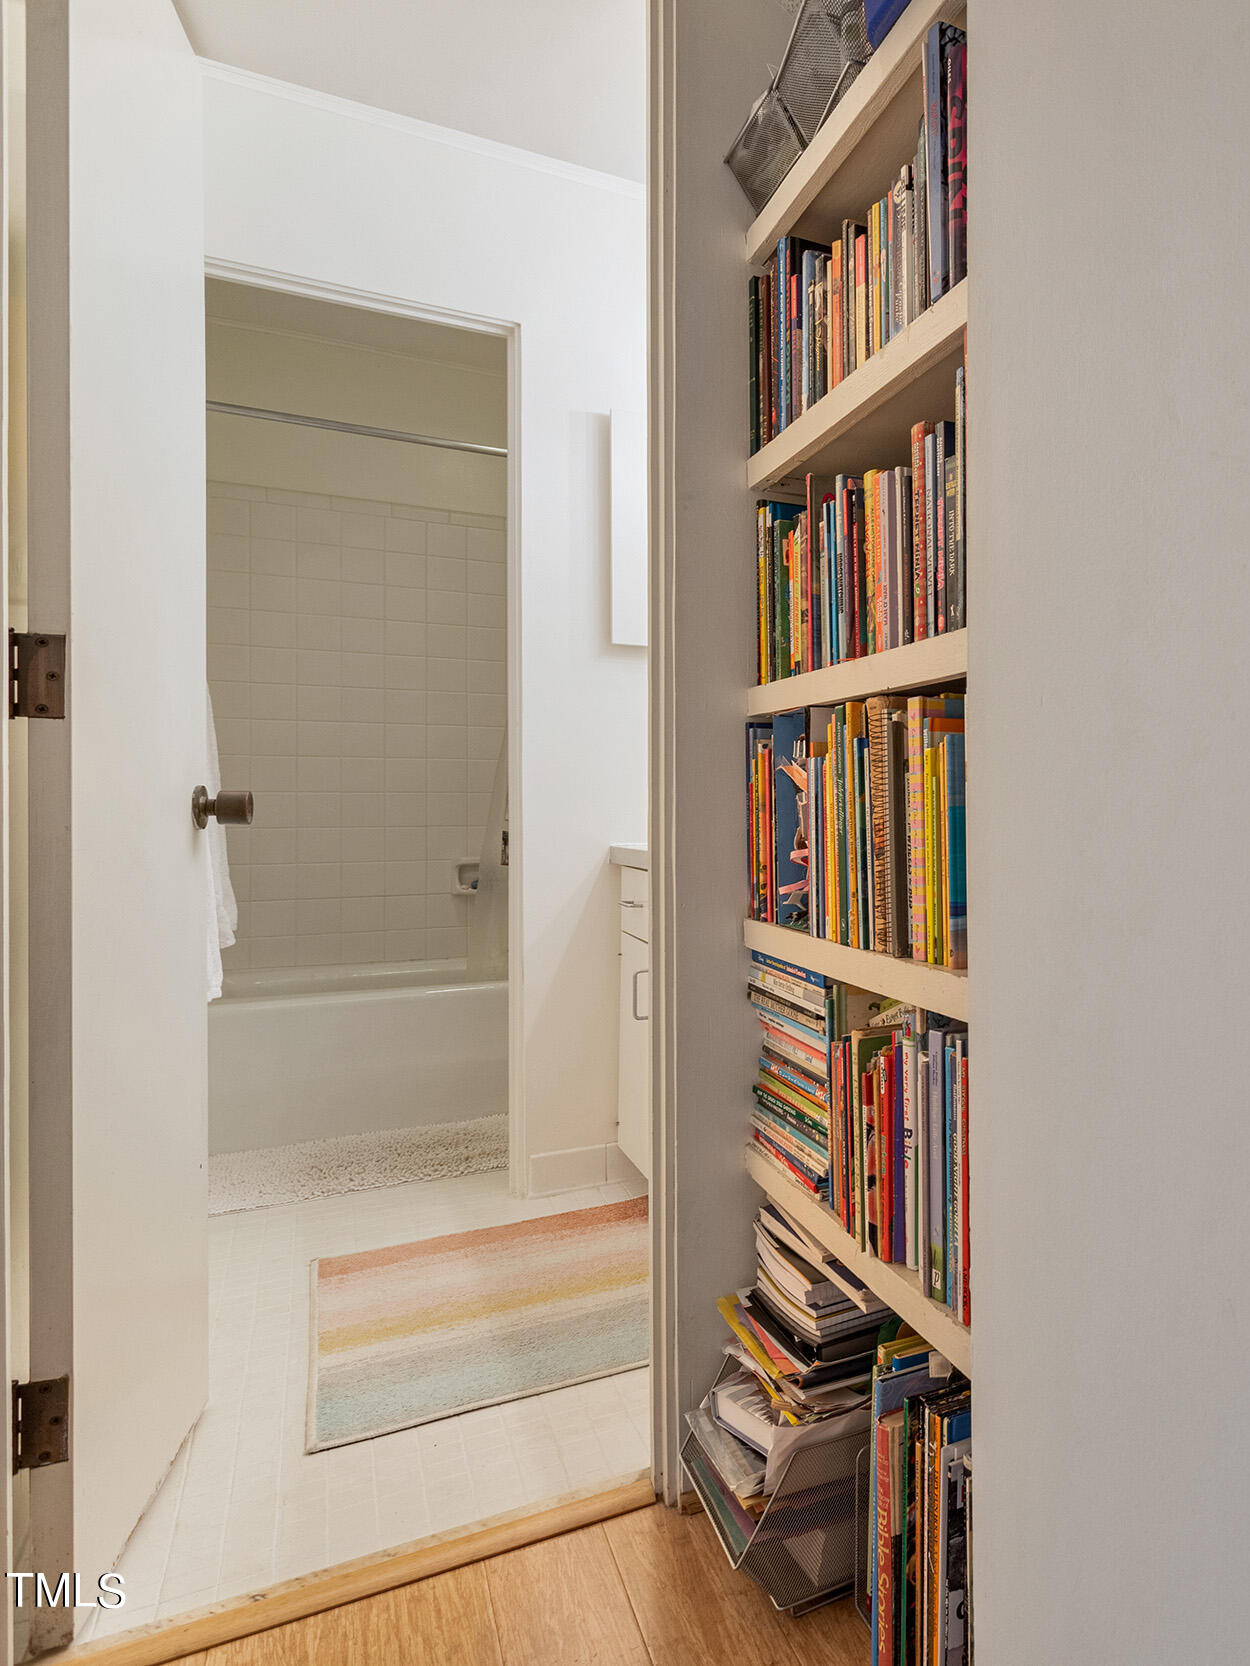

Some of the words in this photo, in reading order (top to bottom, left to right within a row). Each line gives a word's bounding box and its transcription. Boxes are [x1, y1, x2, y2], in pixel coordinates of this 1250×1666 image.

[904, 1052, 909, 1066] my
[903, 1127, 914, 1170] Bible
[877, 1506, 889, 1566] Bible
[877, 1568, 889, 1654] Stories
